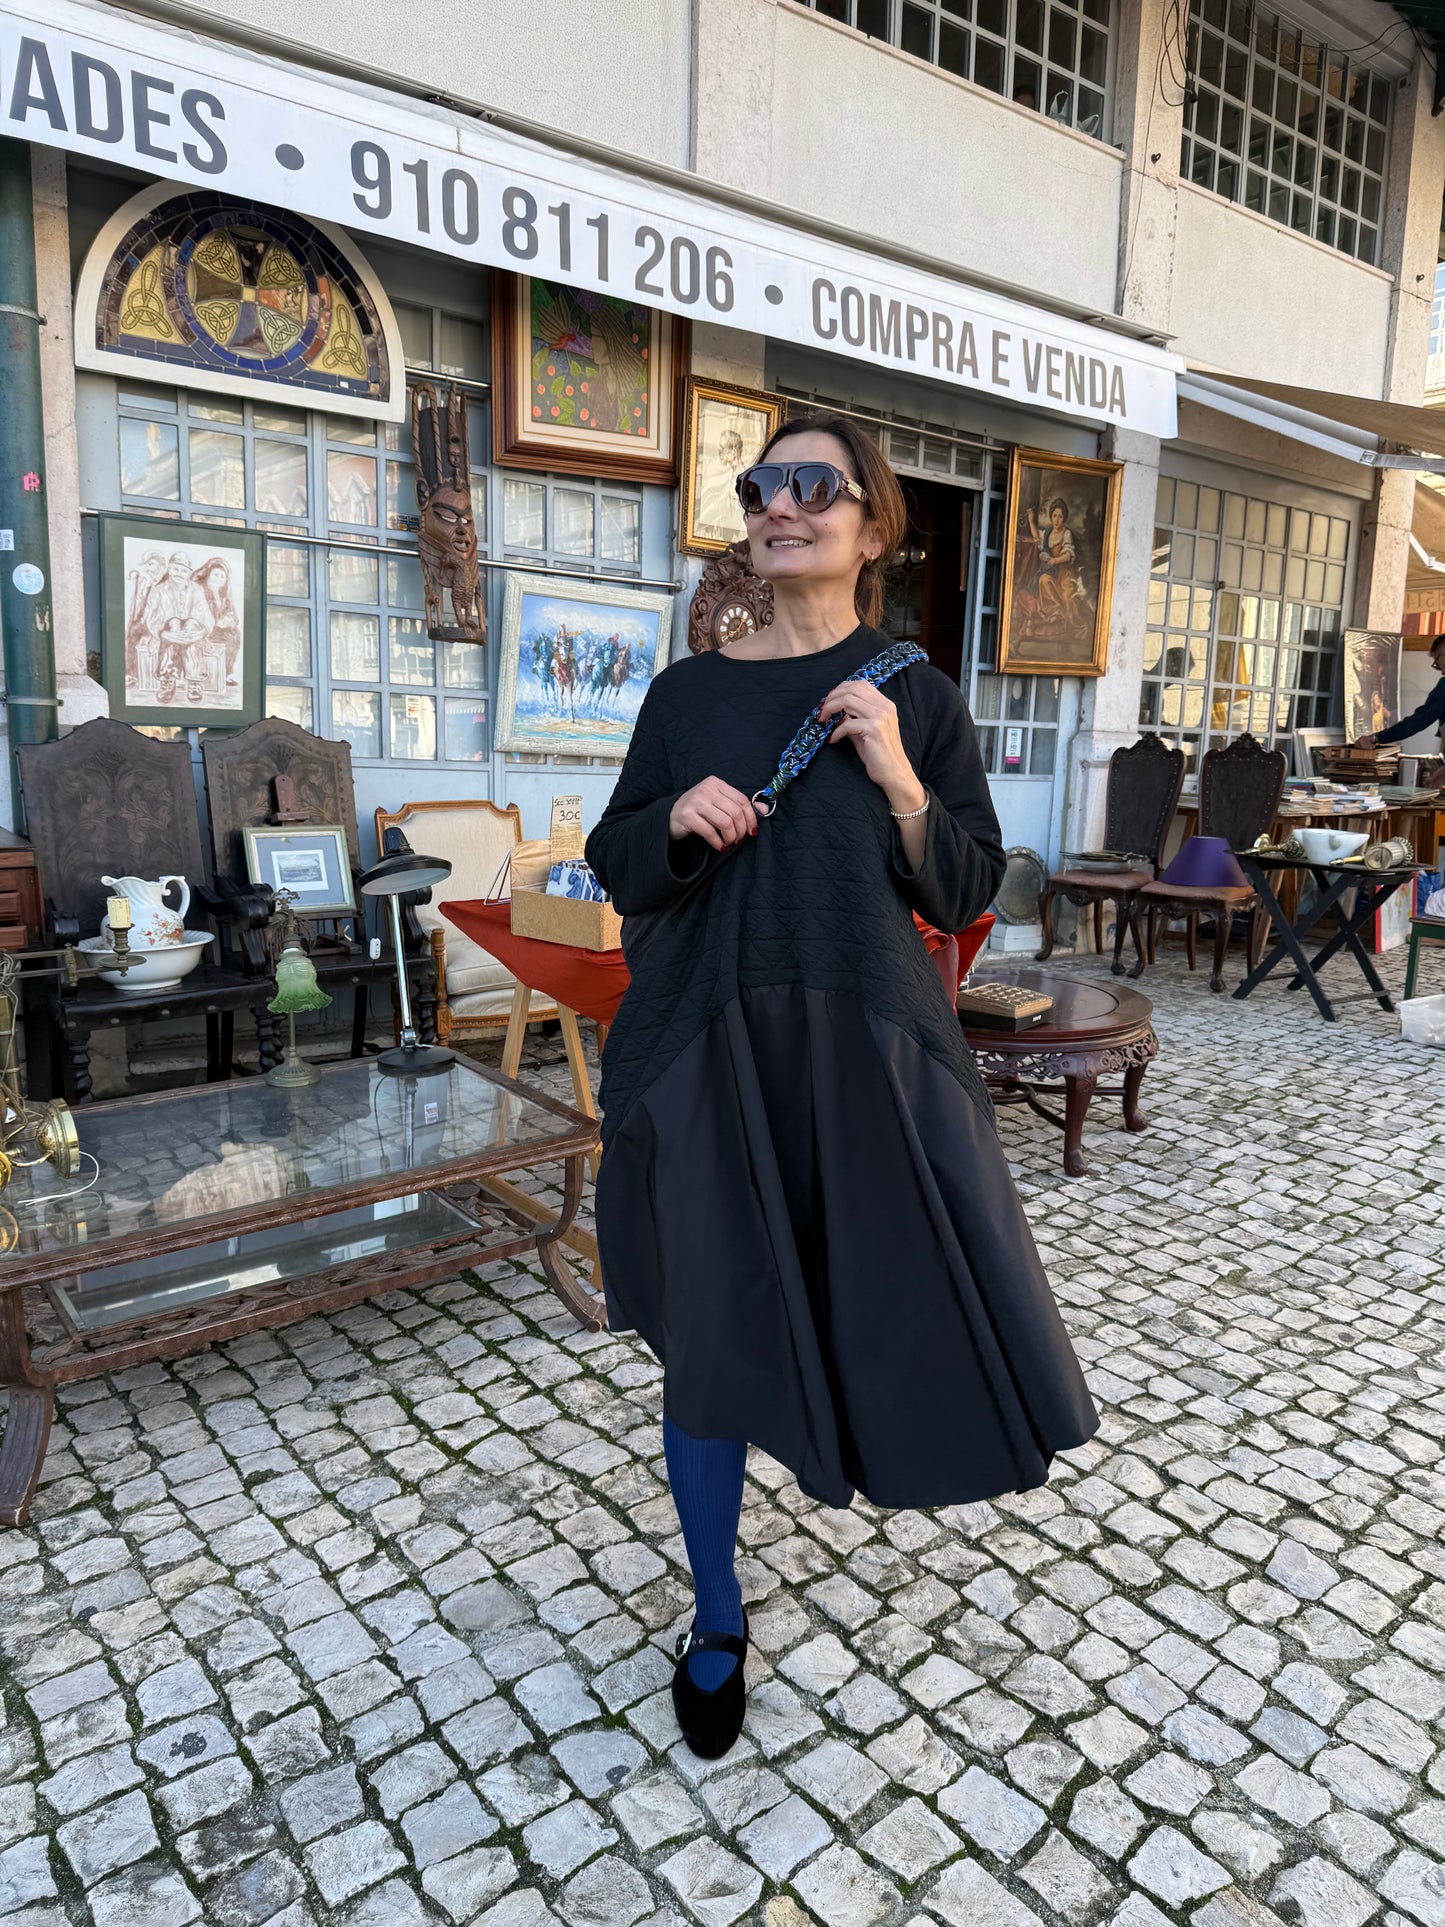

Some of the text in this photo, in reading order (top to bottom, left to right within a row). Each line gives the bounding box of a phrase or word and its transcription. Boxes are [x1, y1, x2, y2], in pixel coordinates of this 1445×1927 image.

[9, 36, 1127, 417] ADES 910 811 206 COMPRA E VENDA
